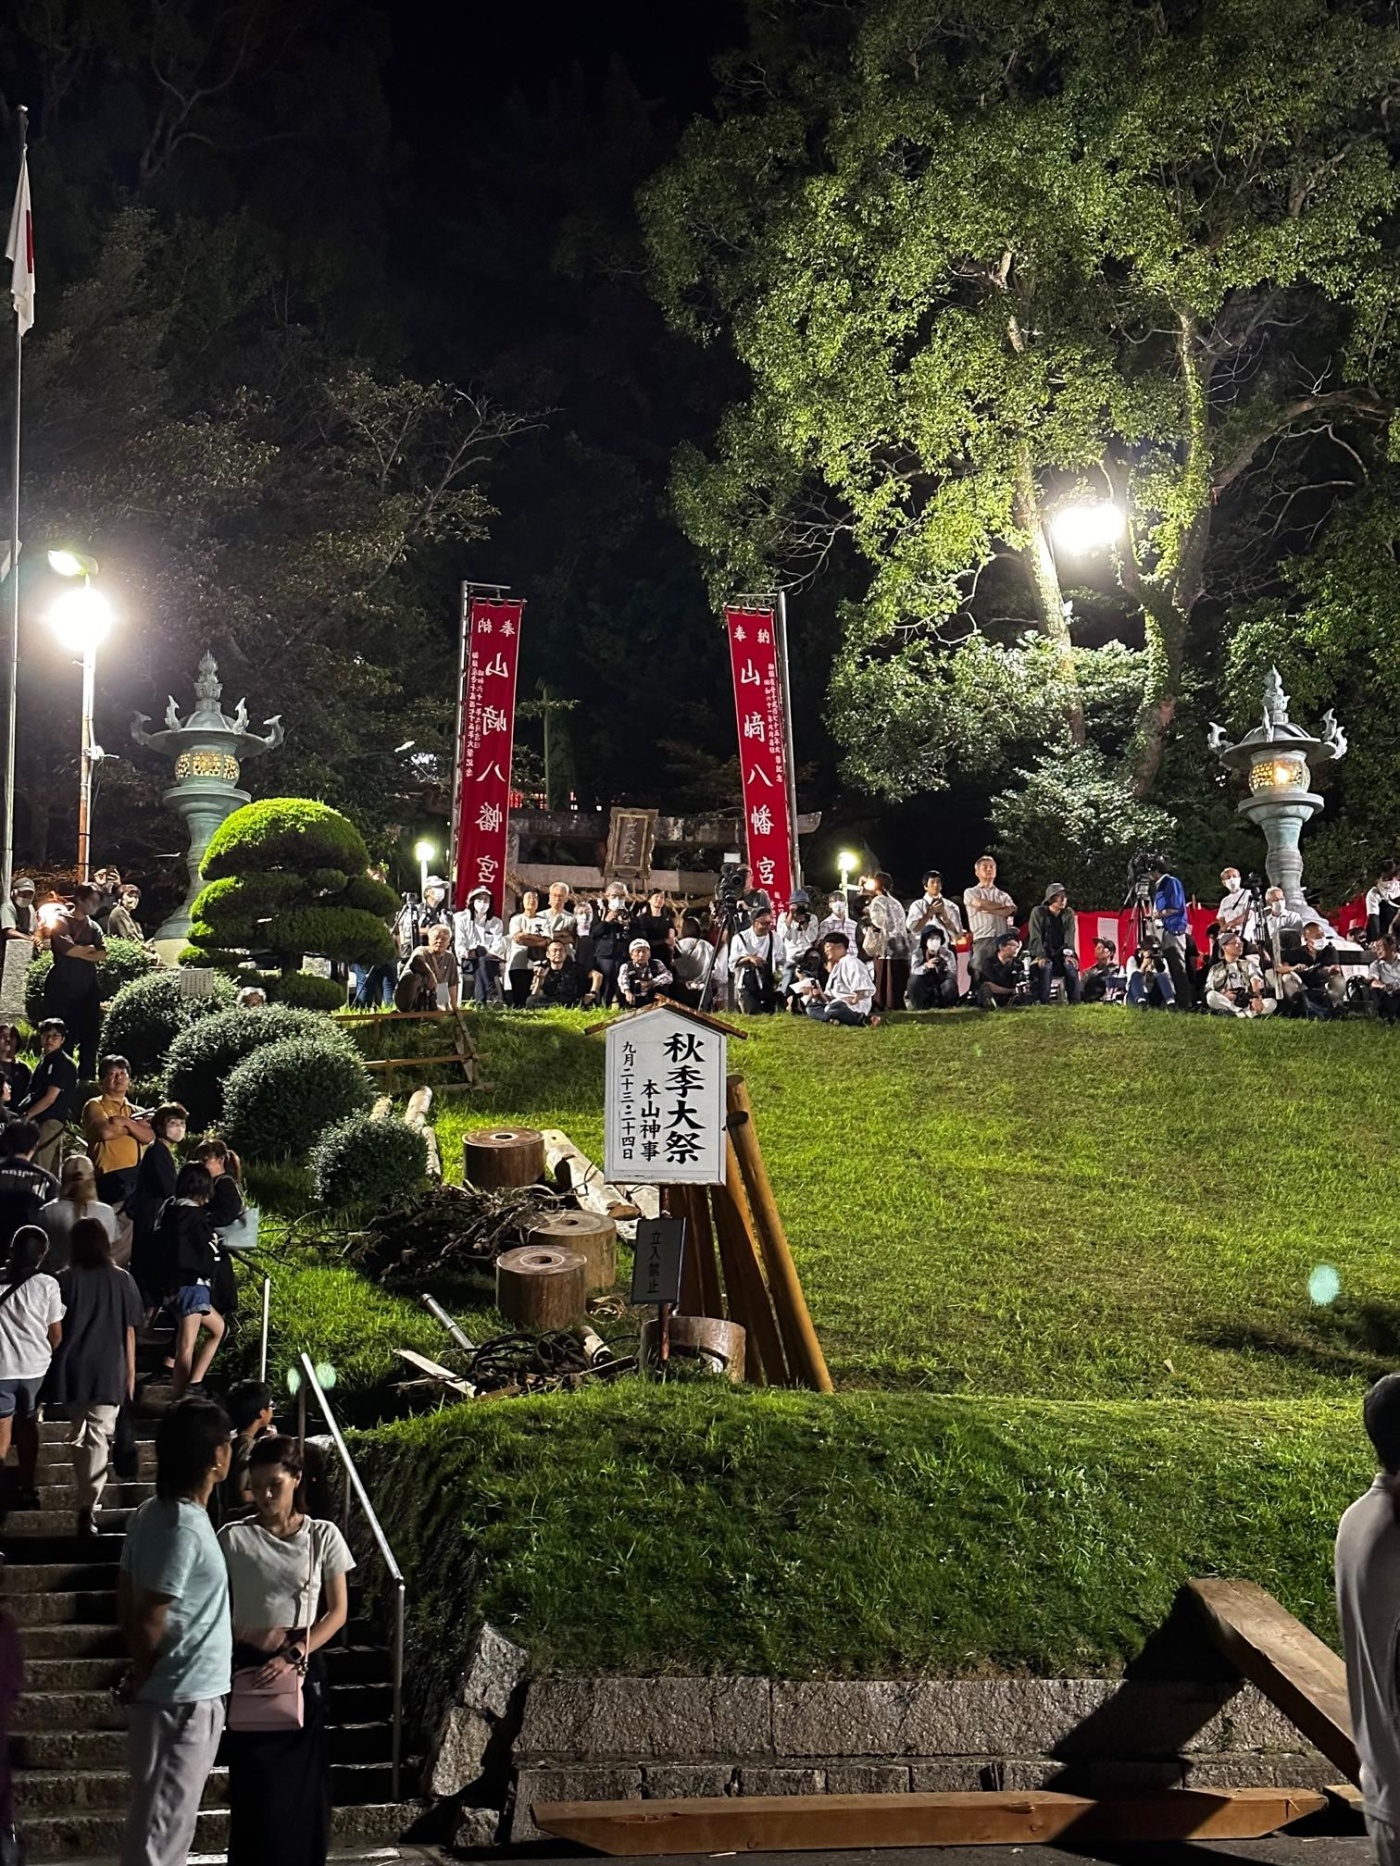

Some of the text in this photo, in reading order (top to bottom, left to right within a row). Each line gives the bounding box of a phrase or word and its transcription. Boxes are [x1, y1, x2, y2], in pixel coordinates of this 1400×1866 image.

[620, 1041, 637, 1160] 九月二十三・二十四日
[639, 1078, 662, 1162] 本山神事
[662, 1032, 706, 1165] 秋季大祭
[647, 1230, 662, 1294] 立入禁止
